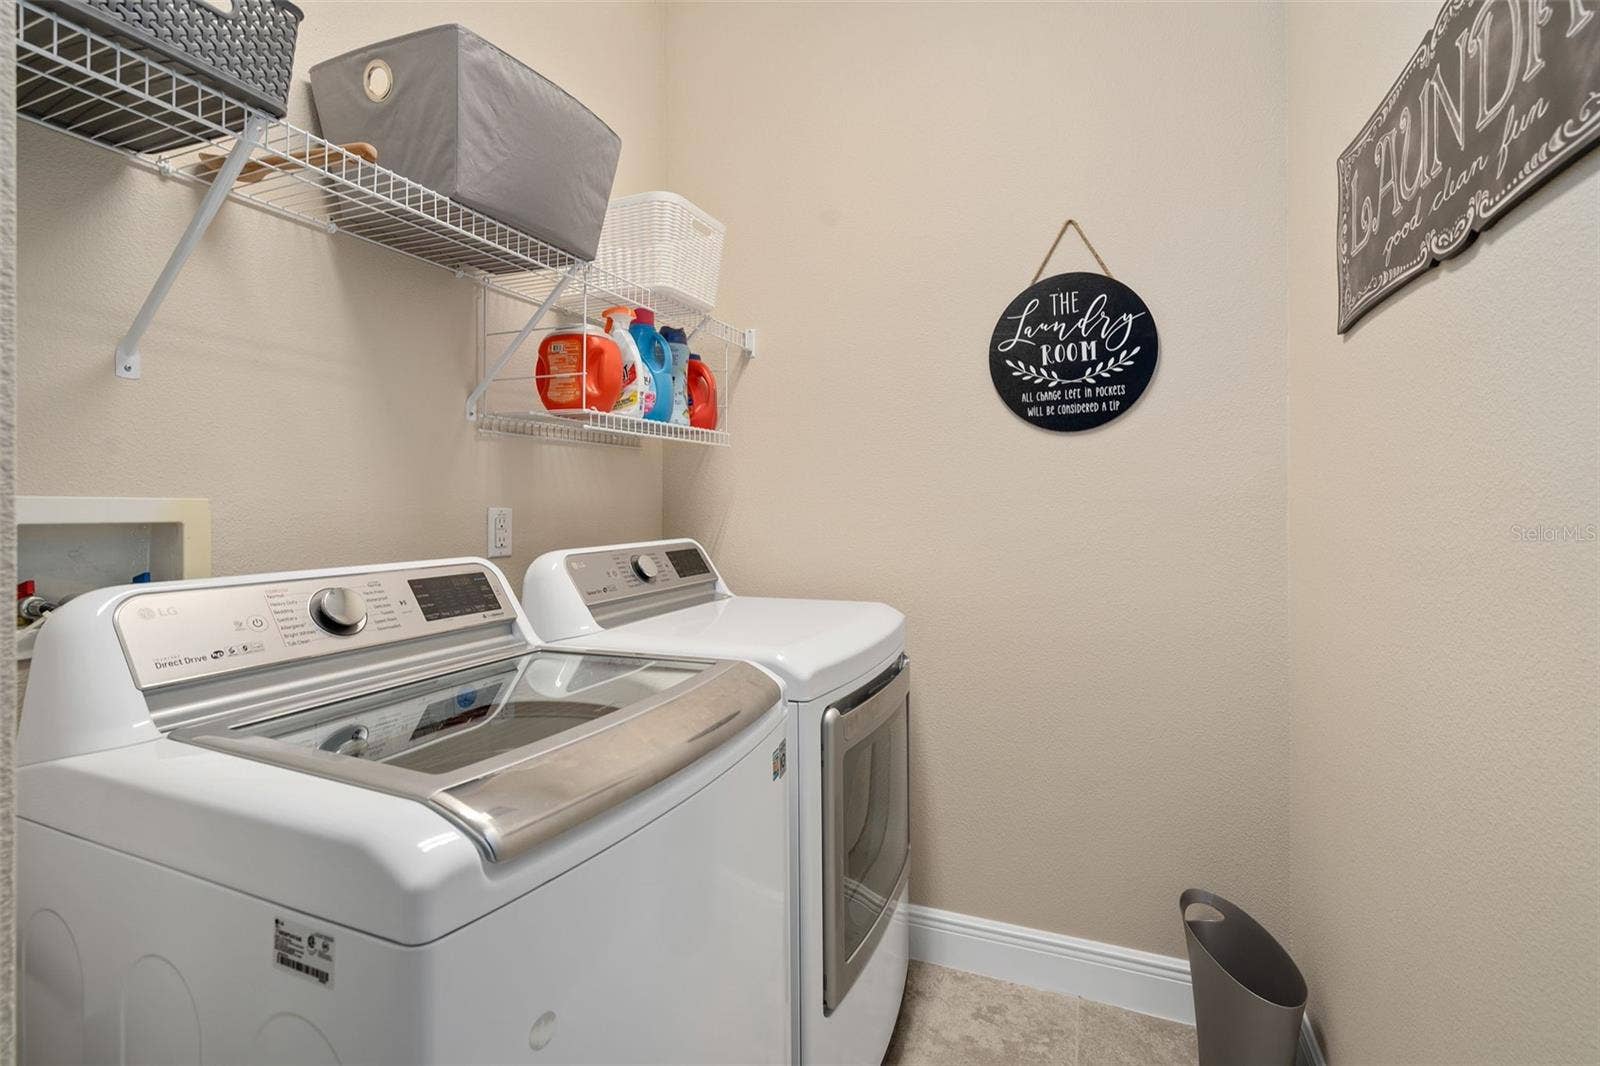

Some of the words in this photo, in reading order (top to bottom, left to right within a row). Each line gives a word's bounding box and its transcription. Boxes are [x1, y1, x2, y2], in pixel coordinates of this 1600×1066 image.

[1383, 196, 1423, 267] good
[1496, 97, 1549, 180] fun
[1050, 290, 1080, 316] THE
[998, 293, 1146, 352] Laundry
[1040, 340, 1098, 366] ROOM
[1021, 392, 1034, 402] ALL
[1101, 401, 1107, 412] A
[158, 606, 179, 617] LG
[154, 658, 183, 670] Direct
[184, 654, 208, 665] Drive
